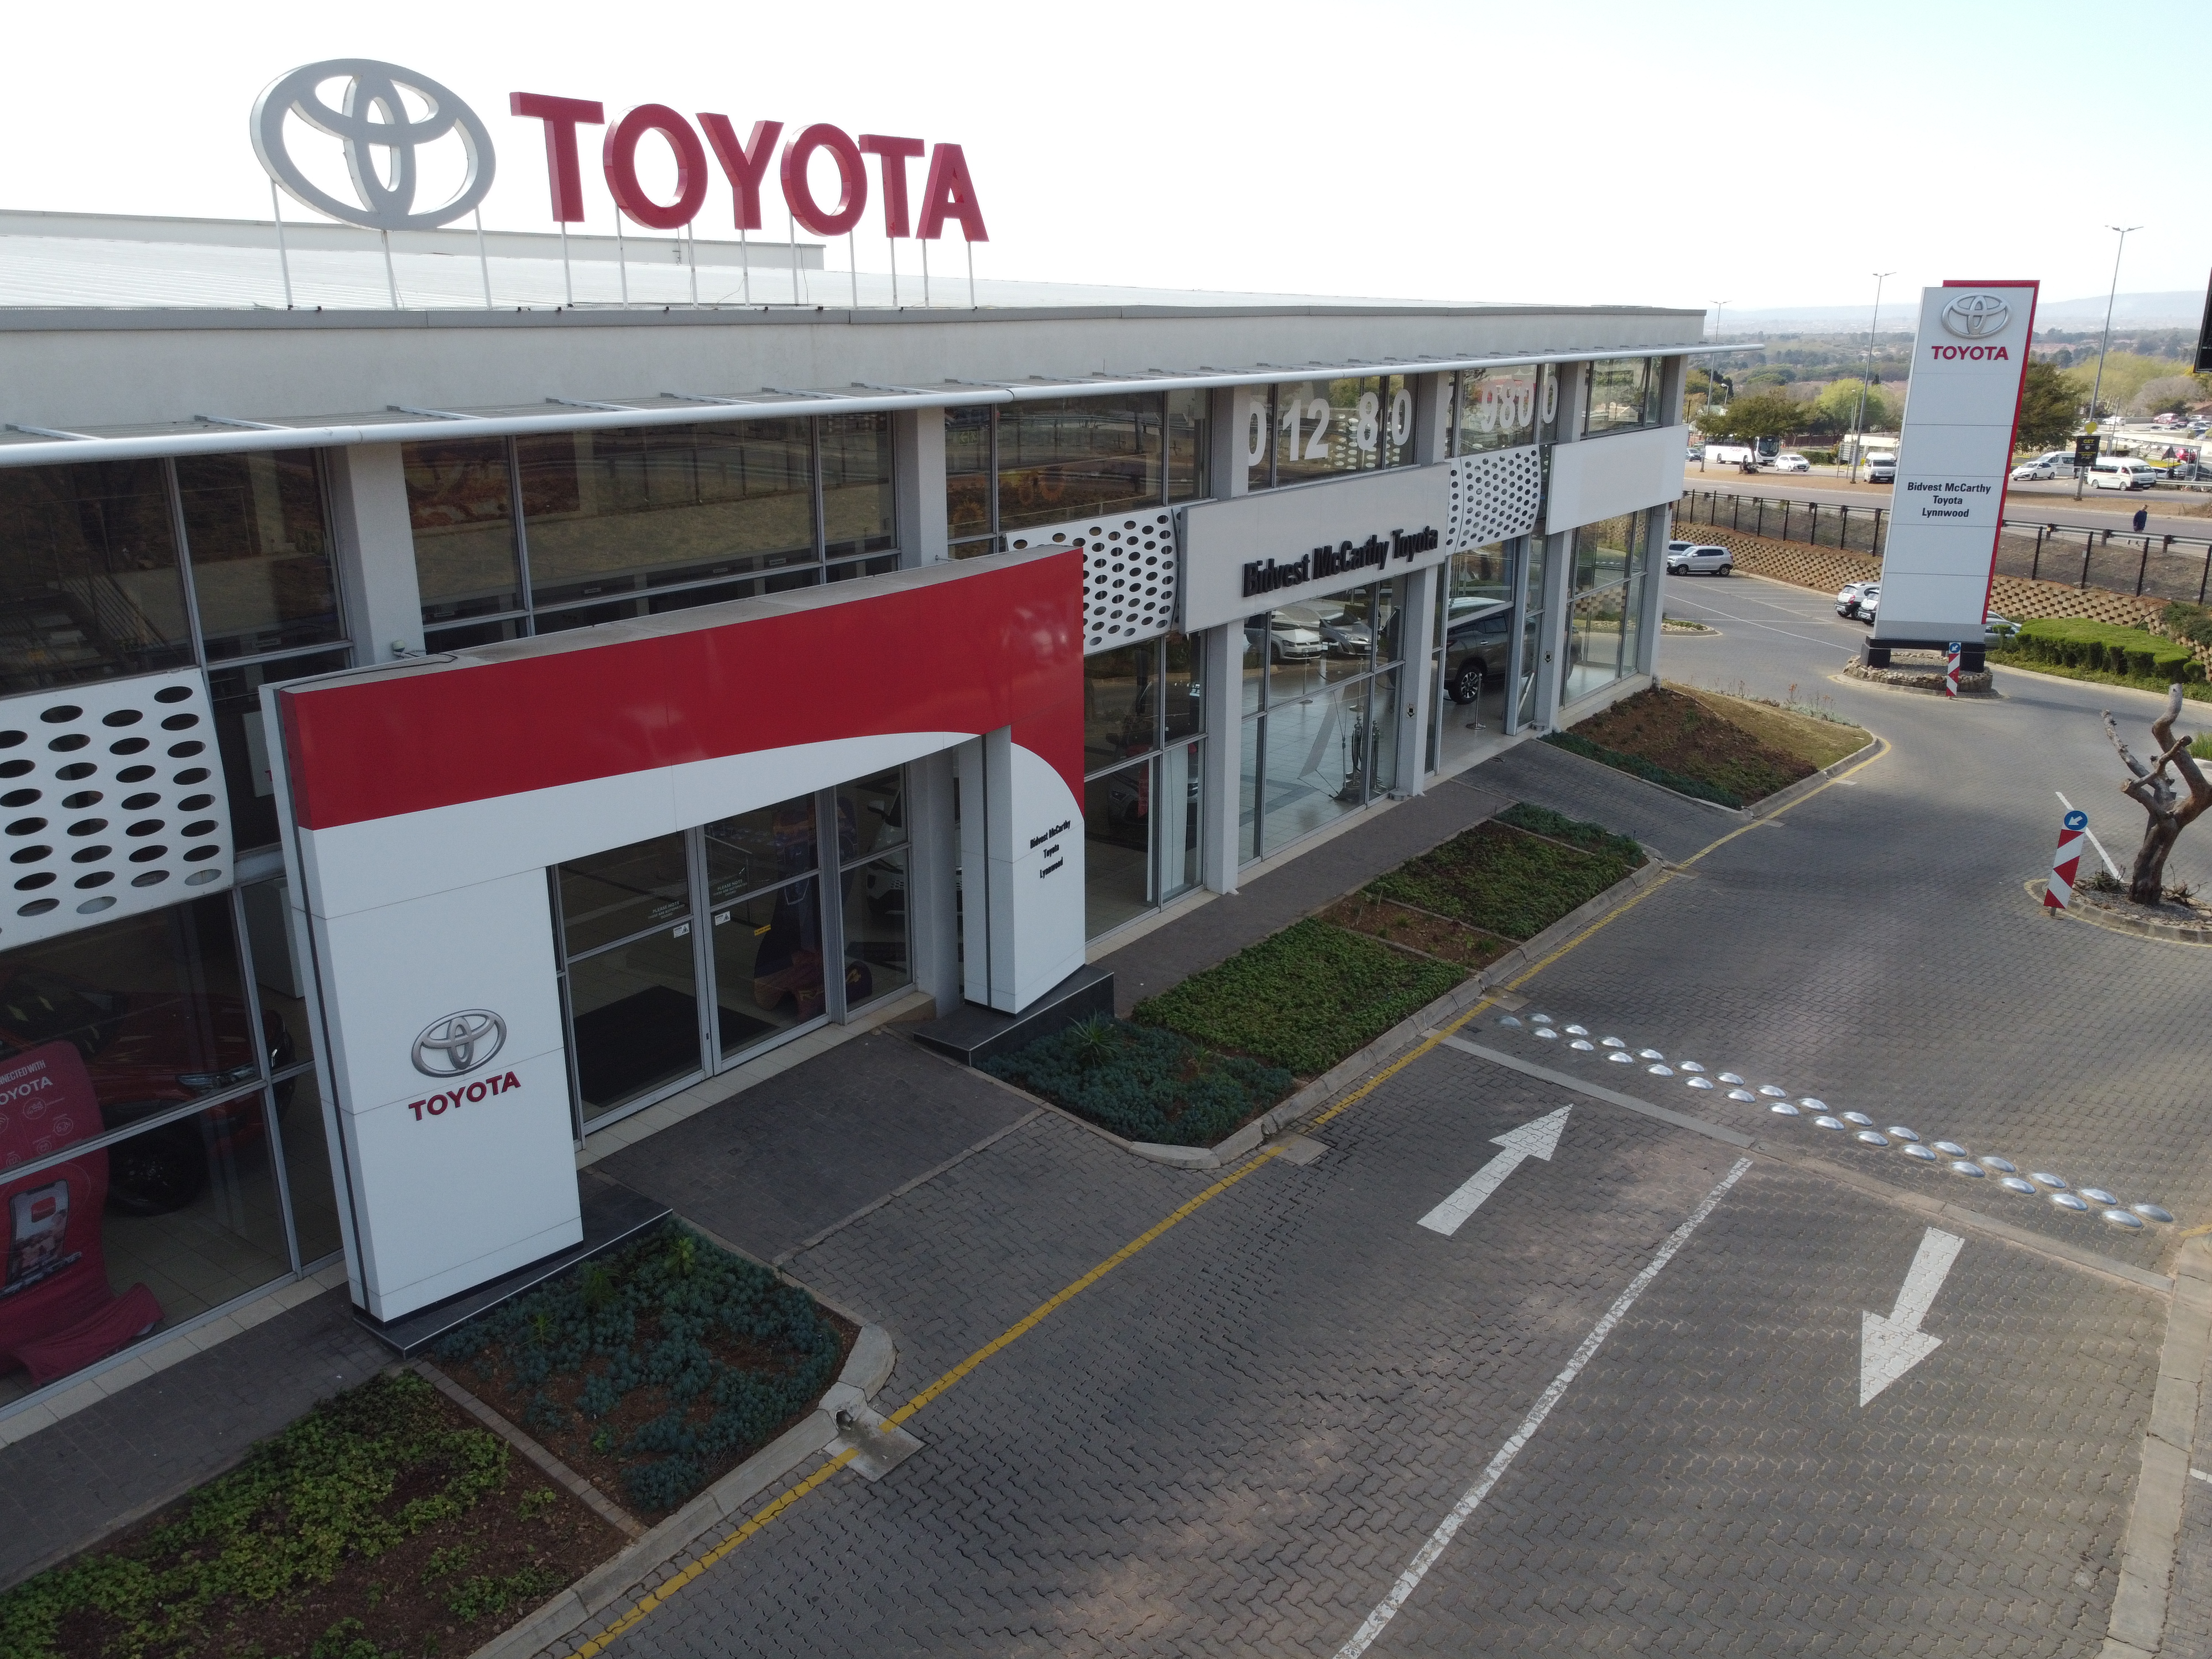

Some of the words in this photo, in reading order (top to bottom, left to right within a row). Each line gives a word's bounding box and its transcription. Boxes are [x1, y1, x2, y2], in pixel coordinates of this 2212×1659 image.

[510, 91, 989, 242] TOYOTA
[1931, 346, 2008, 361] TOYOTA
[1248, 397, 1330, 467] 012
[1480, 375, 1558, 433] 9800
[1907, 482, 1942, 492] Bidvest
[1944, 483, 1992, 495] McCarthy
[1933, 495, 1963, 506] Toyota
[1922, 507, 1969, 518] Lynnwood
[1242, 554, 1311, 597] Bidvest
[1312, 534, 1390, 580] McCarthy
[1391, 525, 1438, 562] Toyota
[1030, 832, 1048, 849] Bidvest
[1049, 820, 1071, 839] McCarthy
[1043, 844, 1060, 859] Toyota
[1040, 856, 1063, 879] Lynnwood
[717, 883, 731, 891] PLEASE
[652, 905, 667, 914] PLEASE
[27, 1060, 46, 1073] WITH
[408, 1071, 521, 1121] TOYOTA
